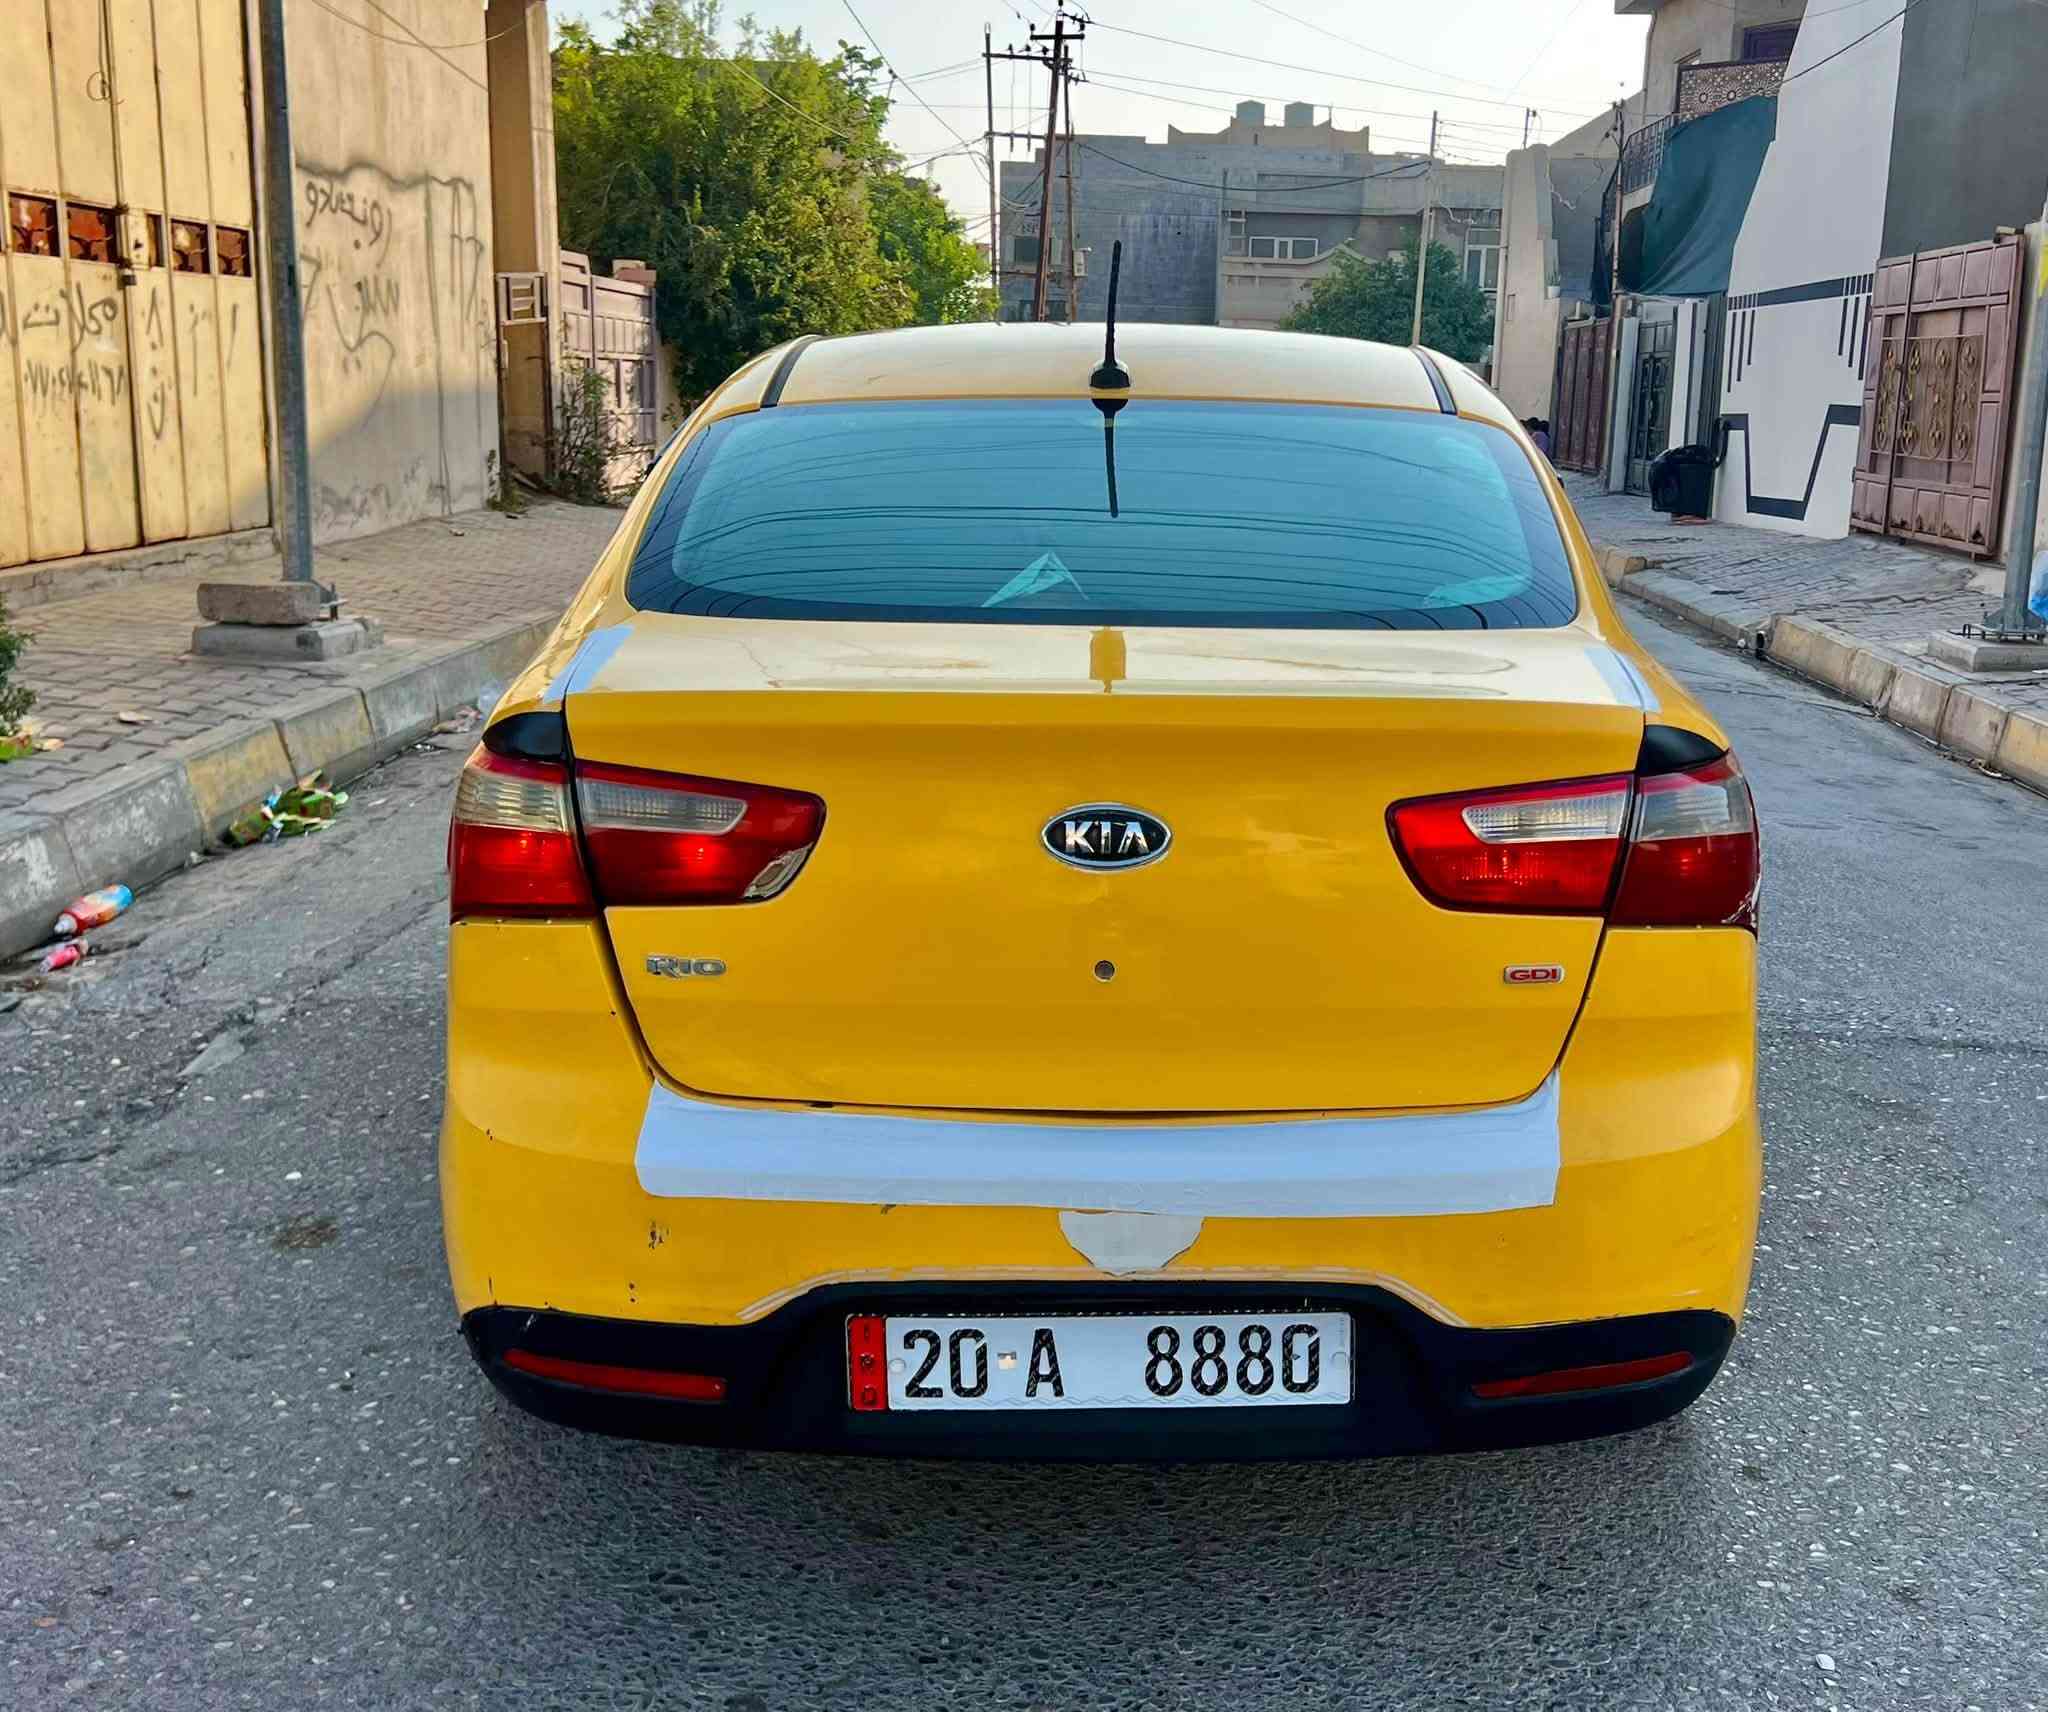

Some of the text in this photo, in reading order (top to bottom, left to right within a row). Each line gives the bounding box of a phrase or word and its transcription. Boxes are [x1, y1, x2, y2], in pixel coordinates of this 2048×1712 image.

[1064, 820, 1150, 854] KIA
[646, 956, 727, 978] RIO
[1509, 967, 1558, 981] GDI
[903, 1328, 989, 1399] 20
[1025, 1327, 1065, 1398] A
[1144, 1323, 1320, 1397] 8880
